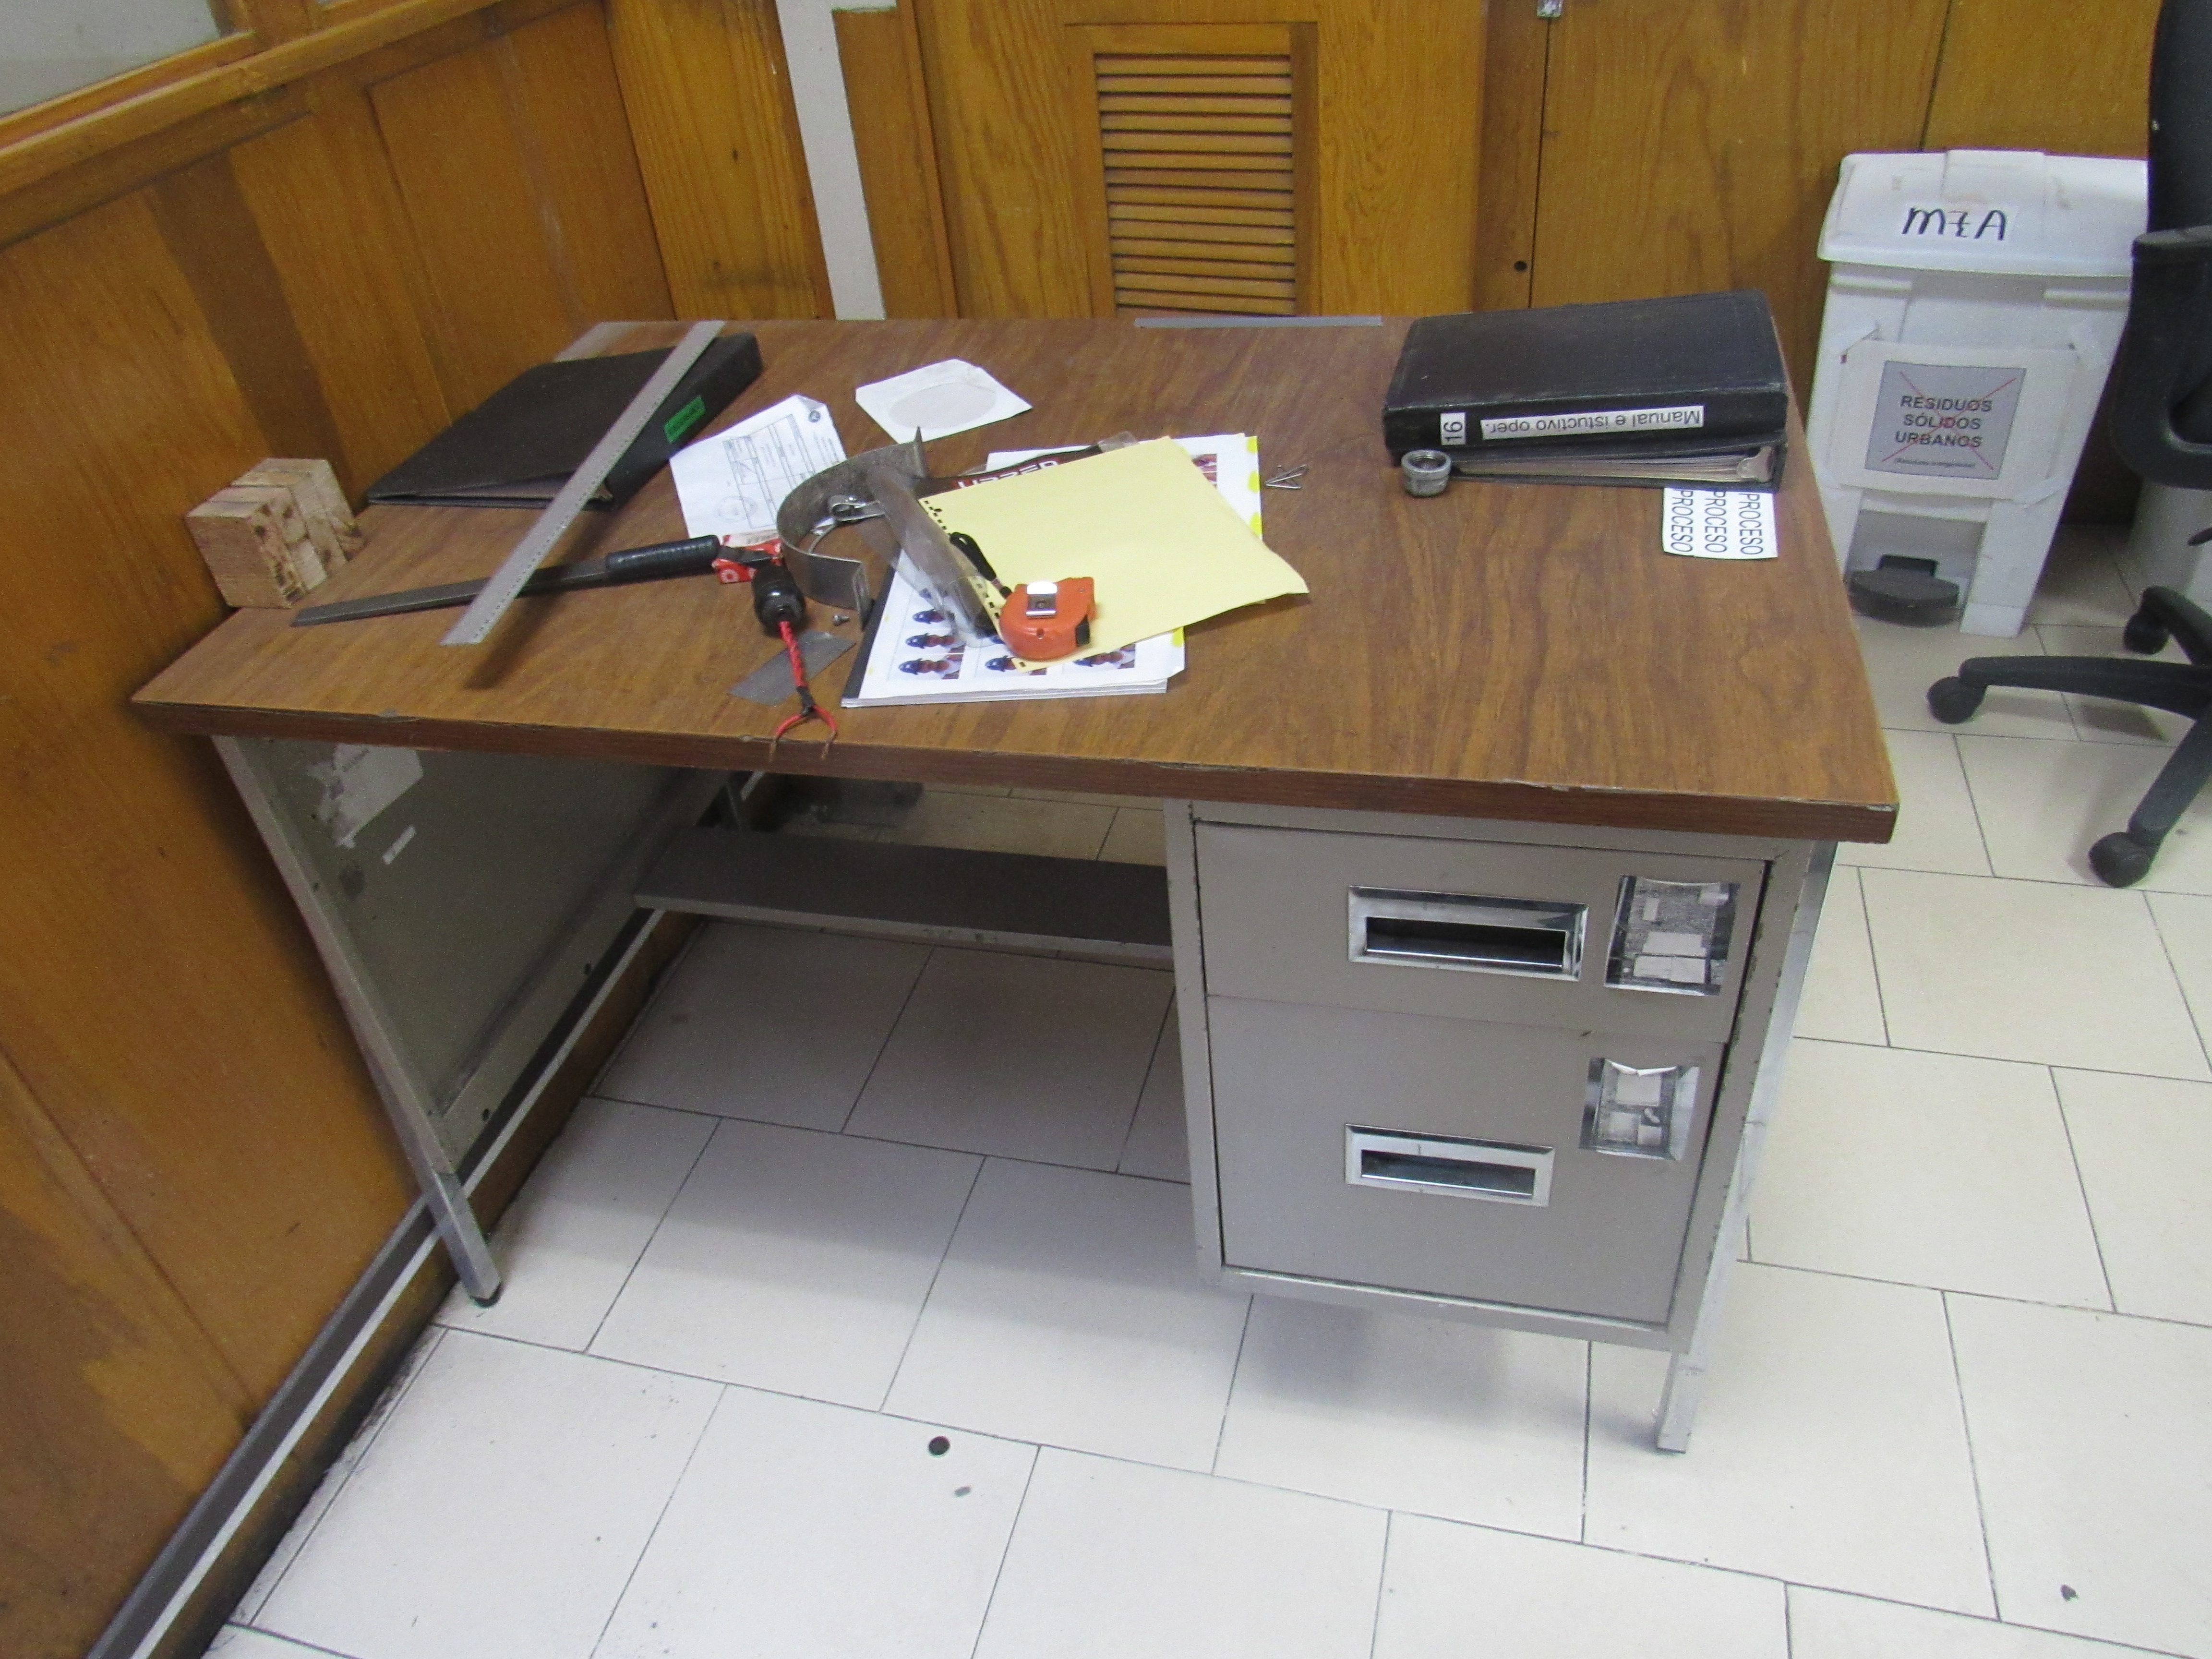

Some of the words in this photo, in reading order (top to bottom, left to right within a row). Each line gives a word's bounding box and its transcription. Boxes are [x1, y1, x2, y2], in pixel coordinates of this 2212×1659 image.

[1900, 396, 1992, 412] RESIDUOS
[1536, 416, 1609, 430] istuctivo
[1614, 415, 1626, 425] e
[1633, 409, 1701, 426] Manual
[1904, 413, 1981, 429] SÓLIDOS
[1443, 421, 1463, 442] 16
[1485, 420, 1530, 434] oper.
[1896, 431, 1983, 447] URBANOS
[1671, 489, 1694, 553] PROCESO
[1705, 491, 1727, 553] PROCESO
[1738, 493, 1764, 555] PROCESO
